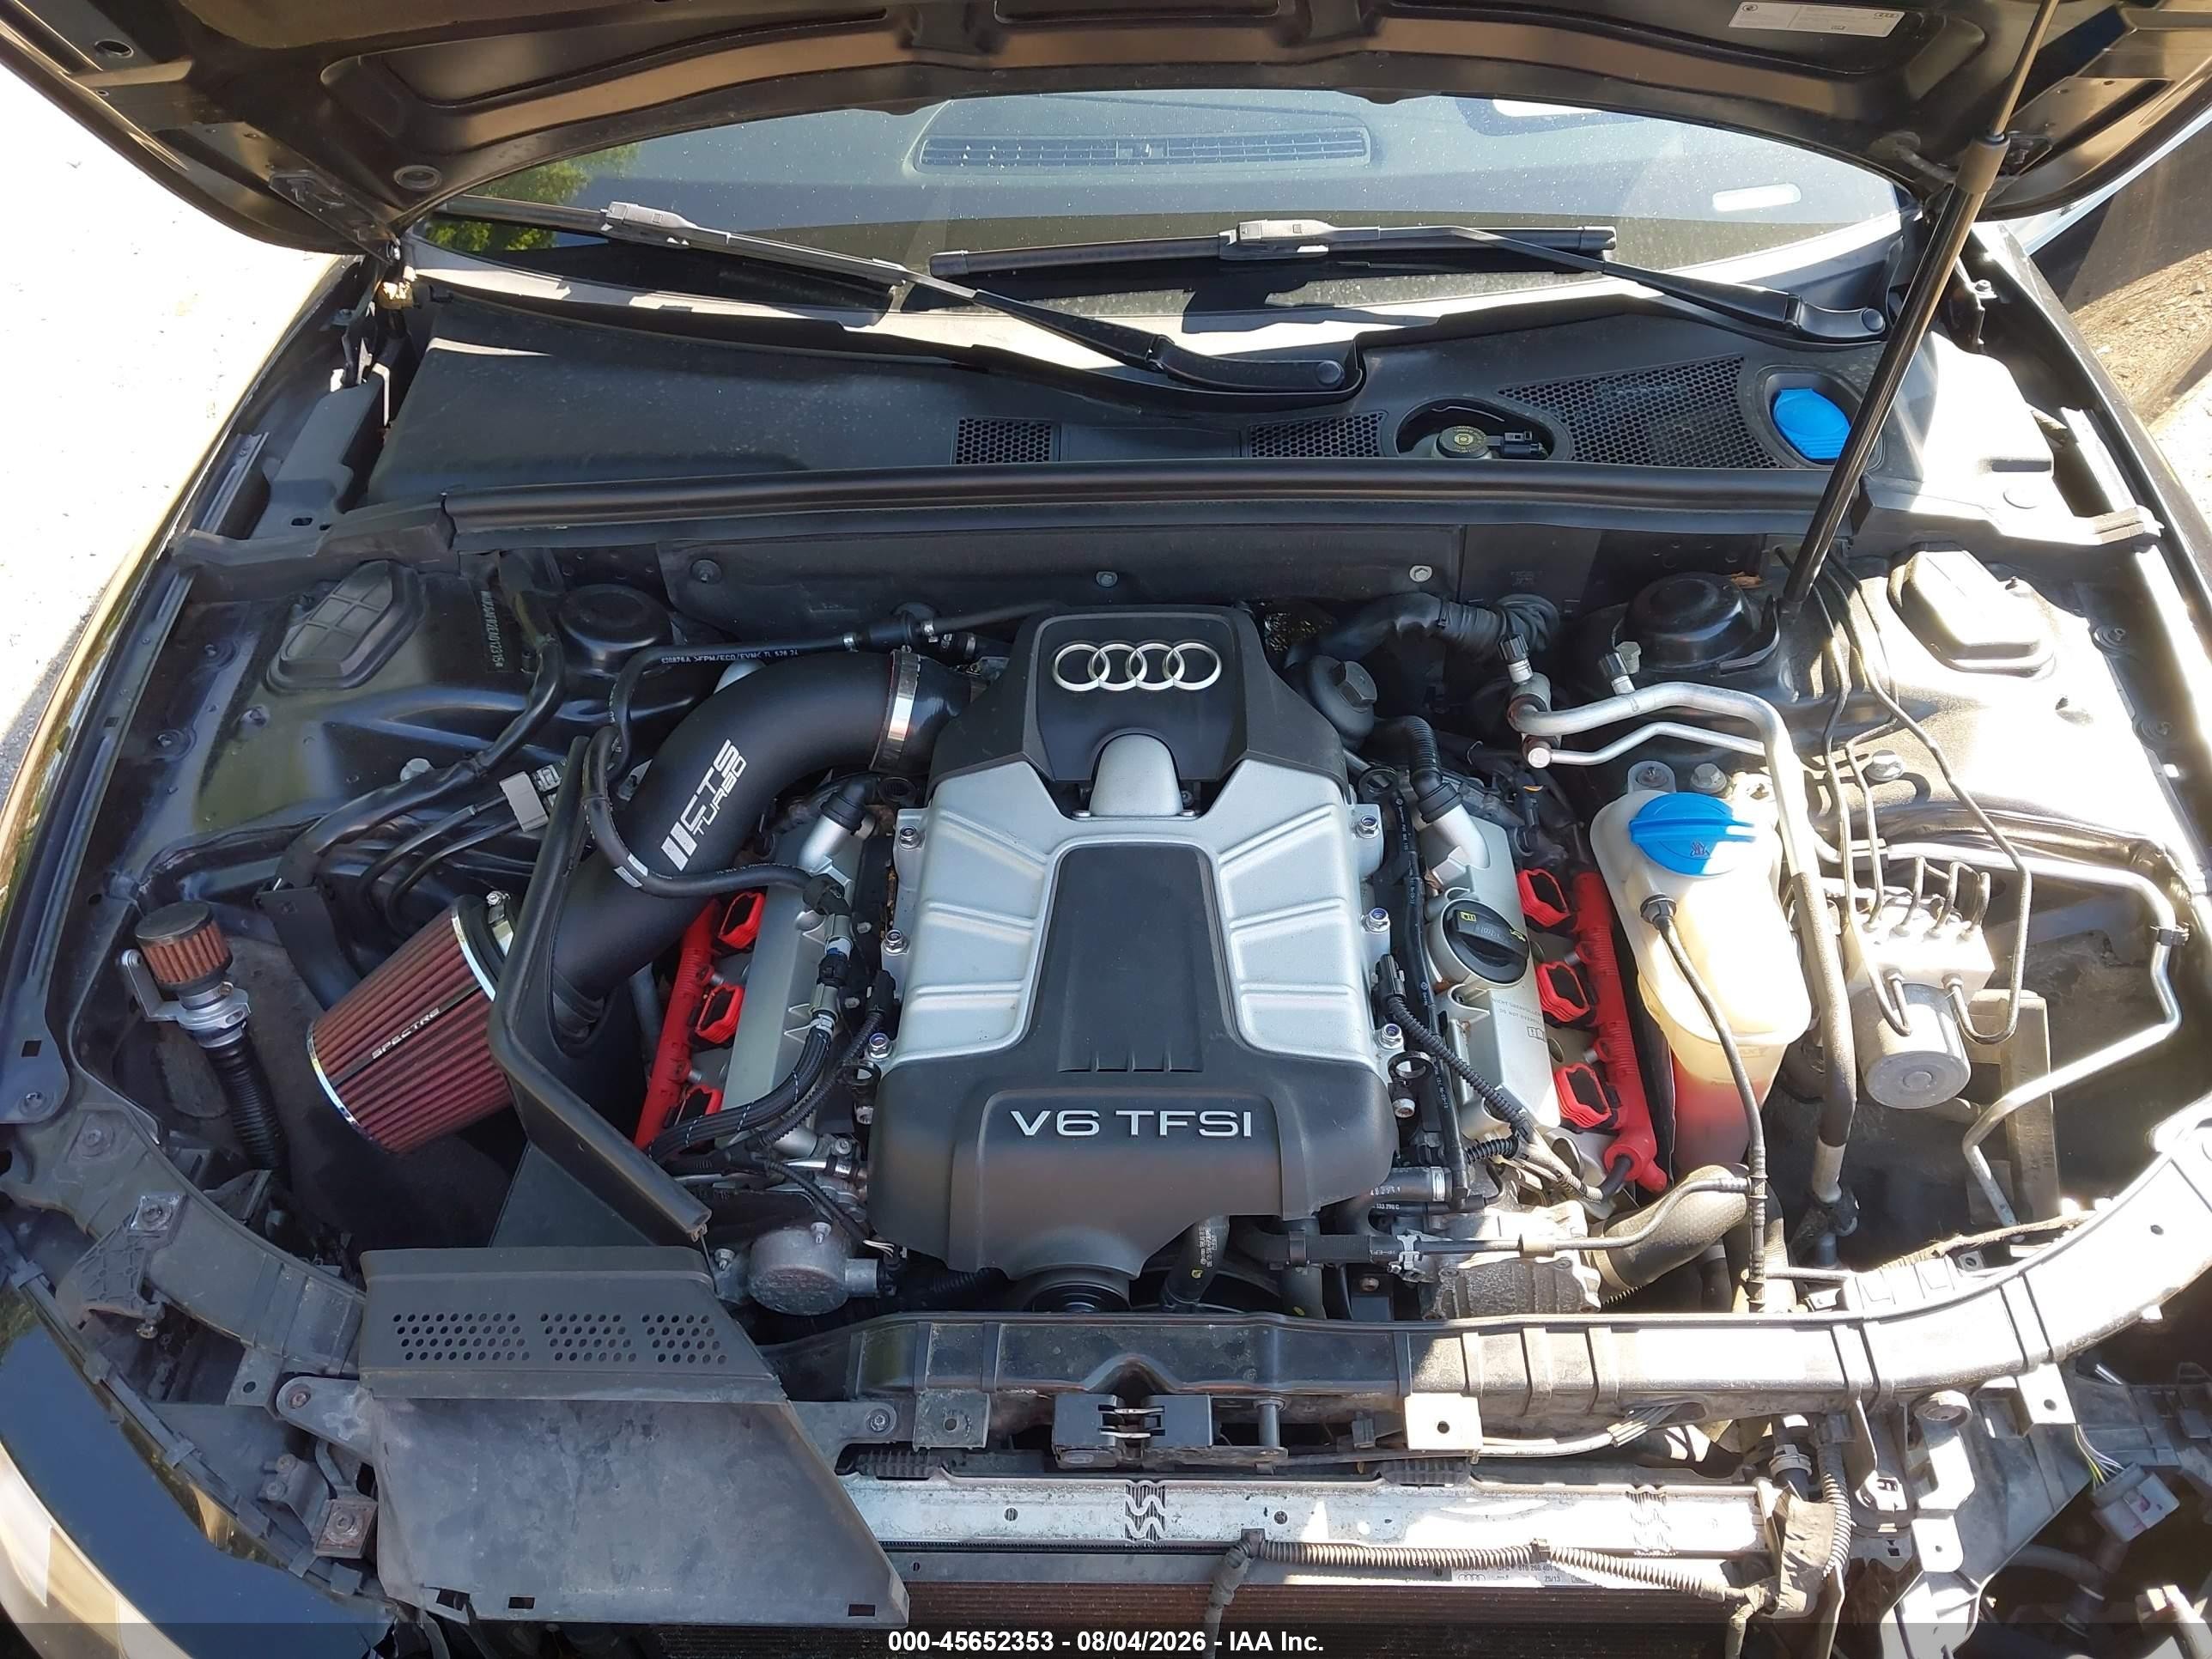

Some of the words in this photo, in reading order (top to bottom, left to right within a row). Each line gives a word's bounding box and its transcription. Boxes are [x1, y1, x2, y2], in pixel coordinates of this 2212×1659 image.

[680, 738, 740, 832] CTS
[692, 755, 747, 836] TURBO
[371, 1006, 441, 1060] SPECTRE
[1011, 1110, 1100, 1137] V6
[1115, 1110, 1252, 1137] TFSI
